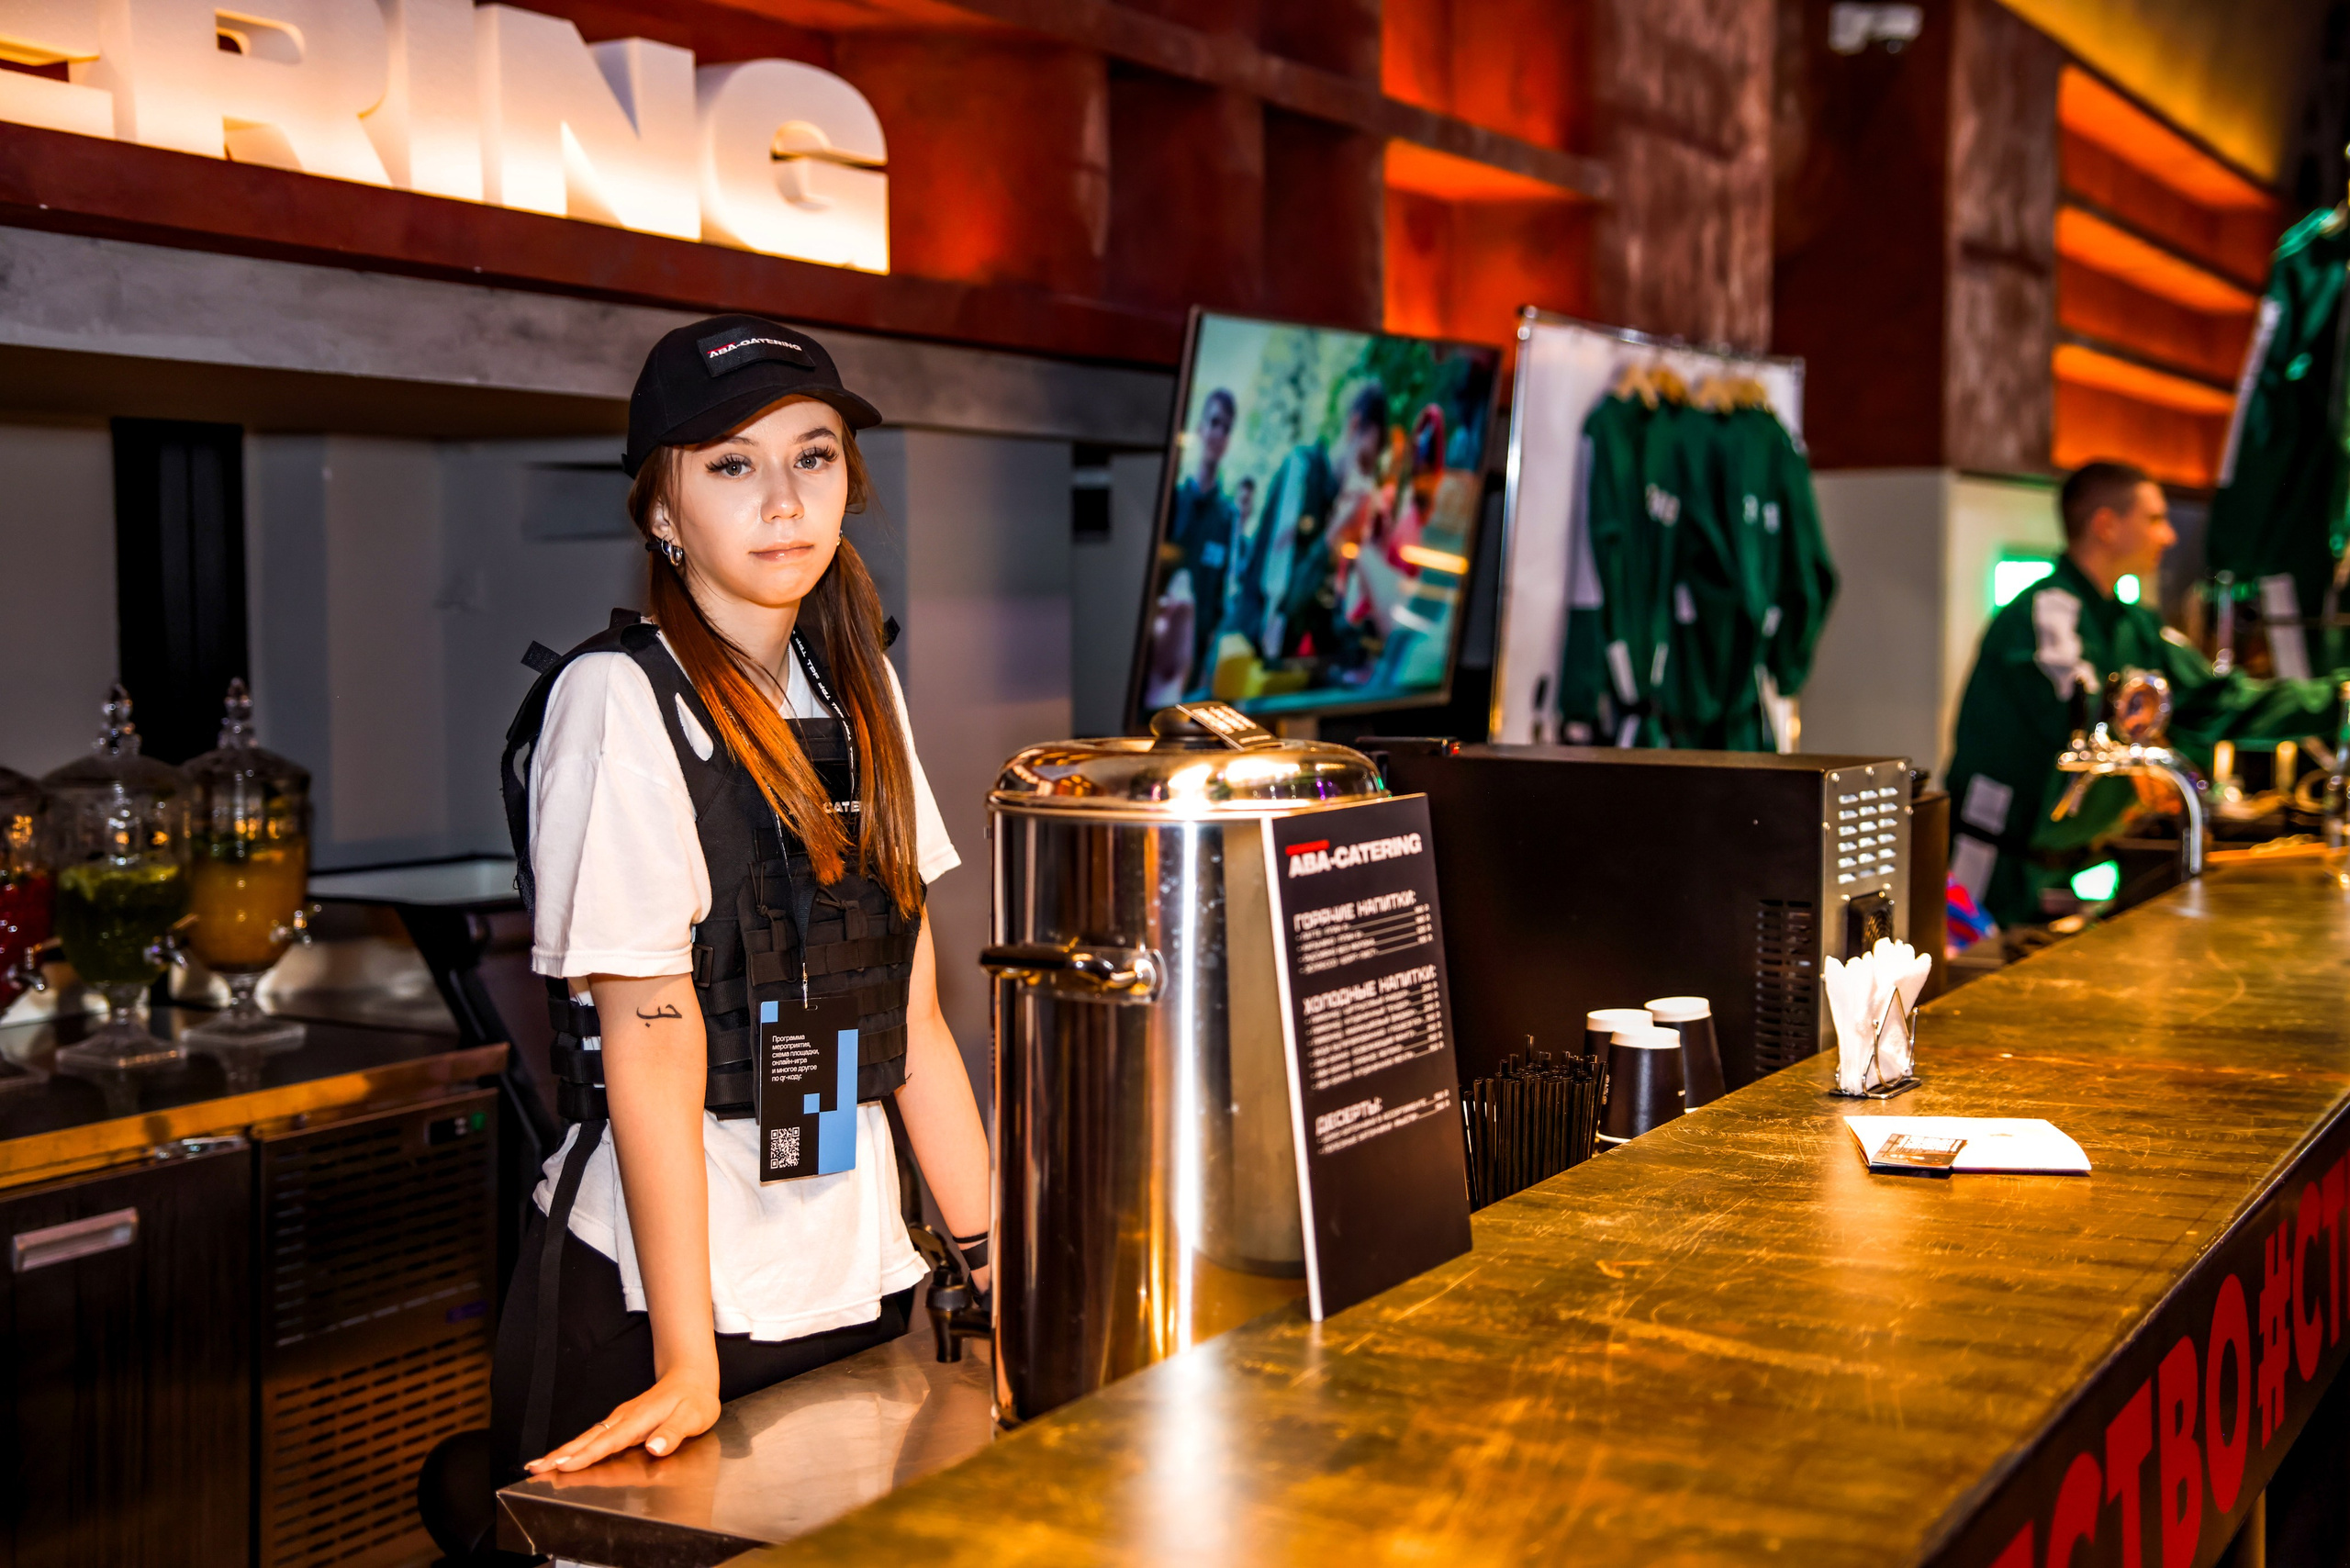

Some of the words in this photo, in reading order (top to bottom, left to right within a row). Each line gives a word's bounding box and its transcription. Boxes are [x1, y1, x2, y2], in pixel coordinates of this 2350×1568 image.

[1288, 832, 1424, 879] ABA-CATERING
[1292, 901, 1357, 933] ГОРЯЧИЕ
[1357, 889, 1417, 918] НАПИТКИ:
[1302, 979, 1378, 1016] ХОЛОДНЫЕ
[1378, 963, 1438, 995] НАПИТКИ:
[636, 1003, 683, 1028] حب
[772, 1035, 805, 1043] Программа
[772, 1042, 811, 1050] мероприятия,
[772, 1058, 807, 1066] онлайн-игра
